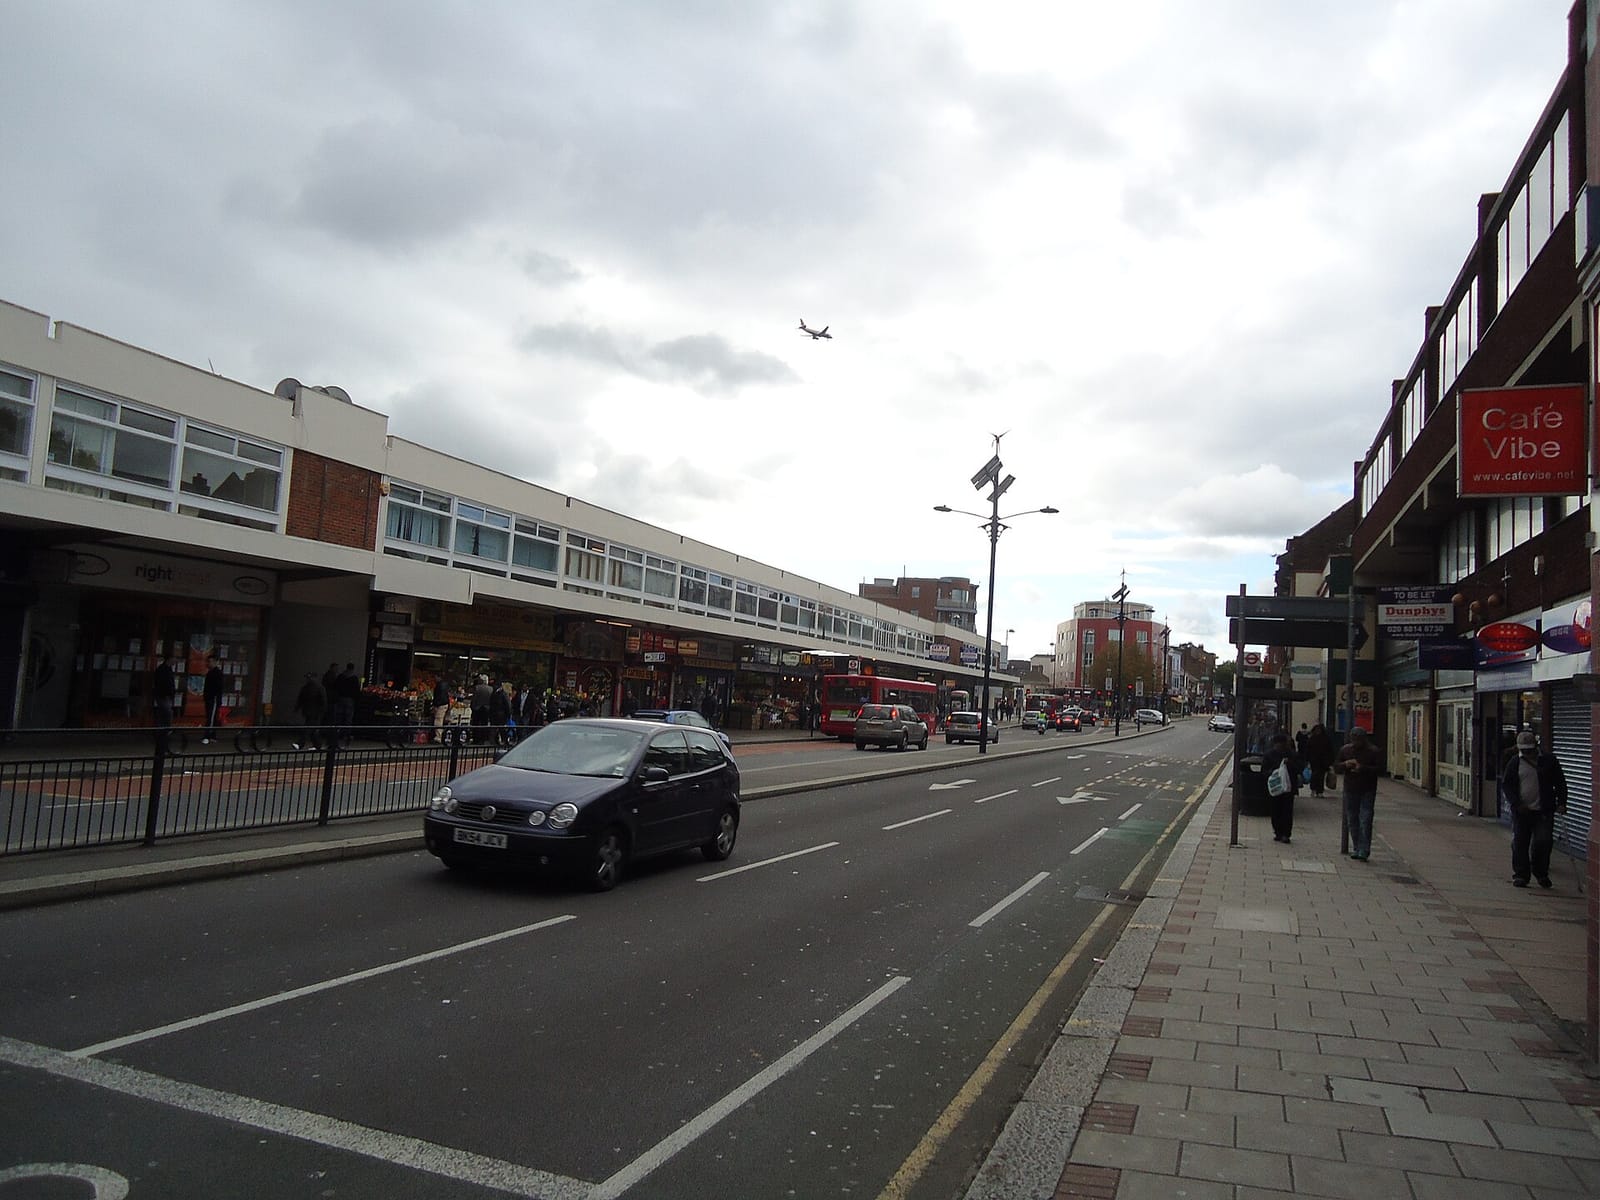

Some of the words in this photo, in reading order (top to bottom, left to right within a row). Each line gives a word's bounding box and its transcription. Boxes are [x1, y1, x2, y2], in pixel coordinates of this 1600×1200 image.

[1482, 401, 1564, 431] Café
[1483, 436, 1561, 460] Vibe
[1472, 469, 1576, 481] www.cafevibe.net
[135, 564, 173, 582] right
[1393, 591, 1406, 600] TO
[1407, 591, 1419, 600] BE
[1420, 591, 1436, 599] LET
[1385, 606, 1446, 617] Dunphys
